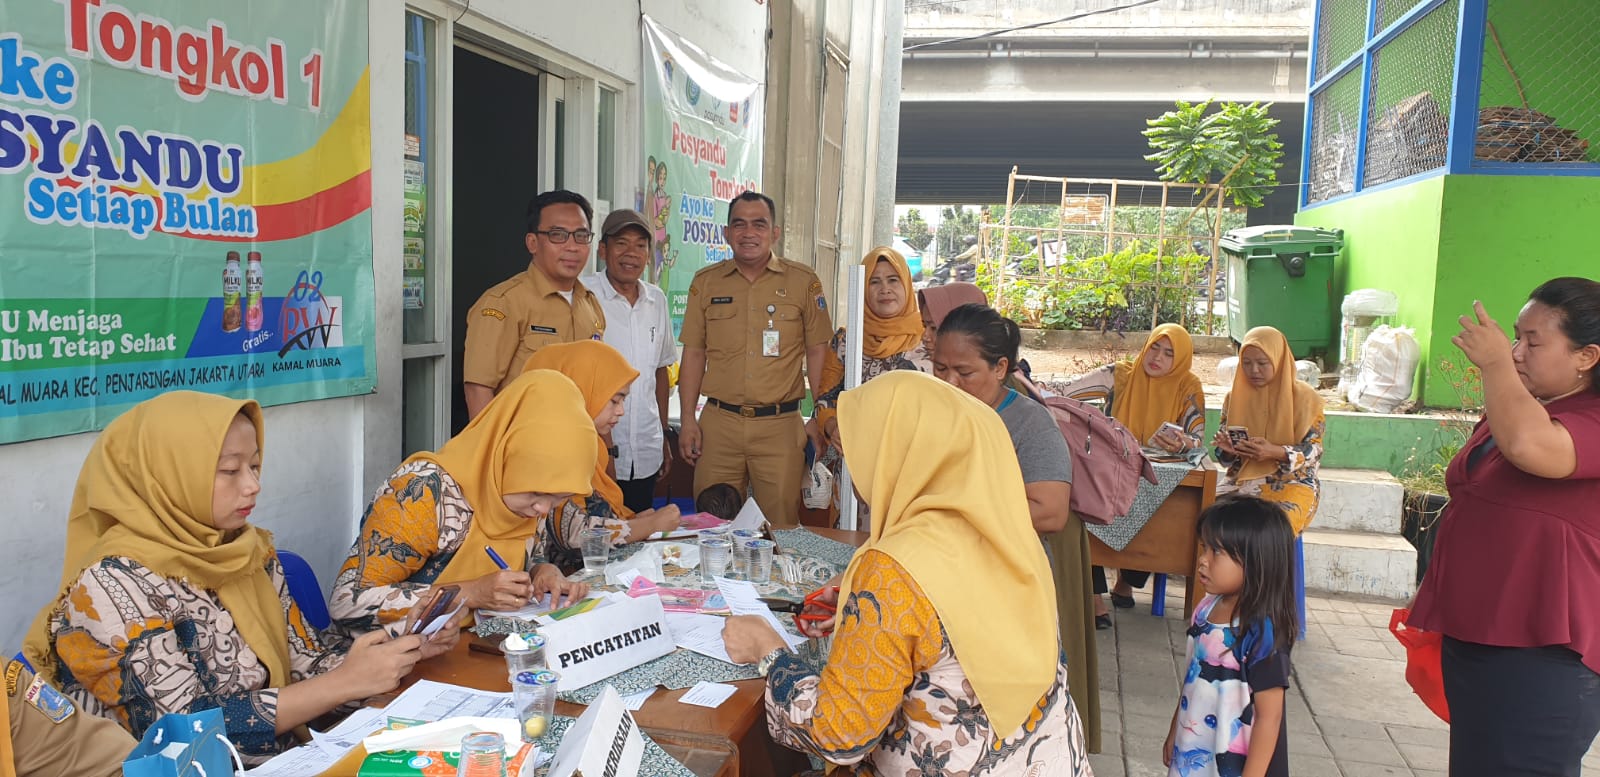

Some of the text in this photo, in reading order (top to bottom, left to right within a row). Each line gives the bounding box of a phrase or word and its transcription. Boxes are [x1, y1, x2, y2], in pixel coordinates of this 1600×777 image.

[0, 38, 75, 104] ke
[70, 0, 321, 107] Tongkol 1
[671, 121, 727, 165] Posyandu
[28, 177, 255, 235] Setiap Bulan
[680, 192, 714, 218] Ayo ke
[294, 270, 323, 302] 02
[1, 309, 123, 336] U Menjaga
[0, 333, 177, 362] Ibu Tetap Sehat
[273, 357, 342, 373] KAMAL MUARA
[20, 380, 69, 404] MUARA
[74, 376, 101, 398] KEC.
[105, 368, 186, 394] PENJARINGAN
[188, 365, 235, 385] JAKARTA
[237, 362, 265, 381] UTARA
[558, 621, 662, 669] PENCATATAN
